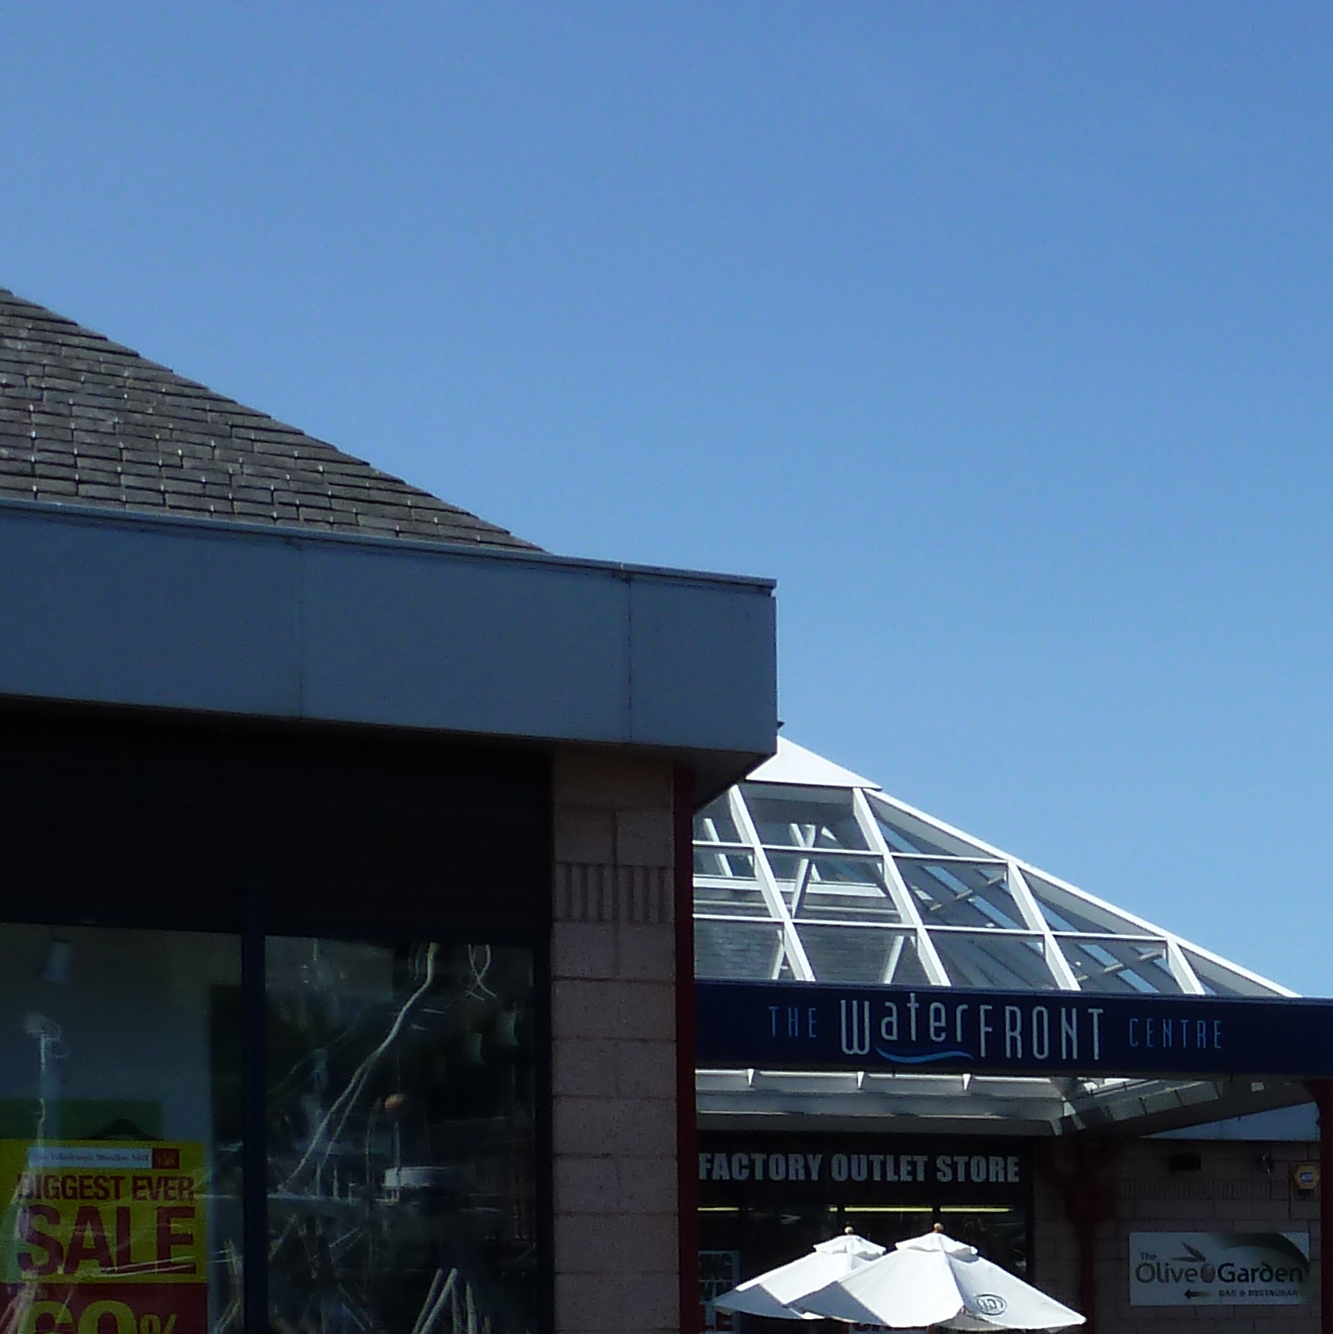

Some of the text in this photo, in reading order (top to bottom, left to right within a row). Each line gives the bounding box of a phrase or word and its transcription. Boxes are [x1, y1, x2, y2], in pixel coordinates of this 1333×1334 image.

[768, 1006, 818, 1038] THE
[1129, 1017, 1223, 1050] CENTRE
[698, 1152, 1020, 1183] FACTORY OUTLET STORE
[131, 1174, 194, 1201] EVER
[16, 1203, 197, 1275] SALE
[1140, 1252, 1157, 1261] The
[1135, 1261, 1304, 1284] Olive Garden
